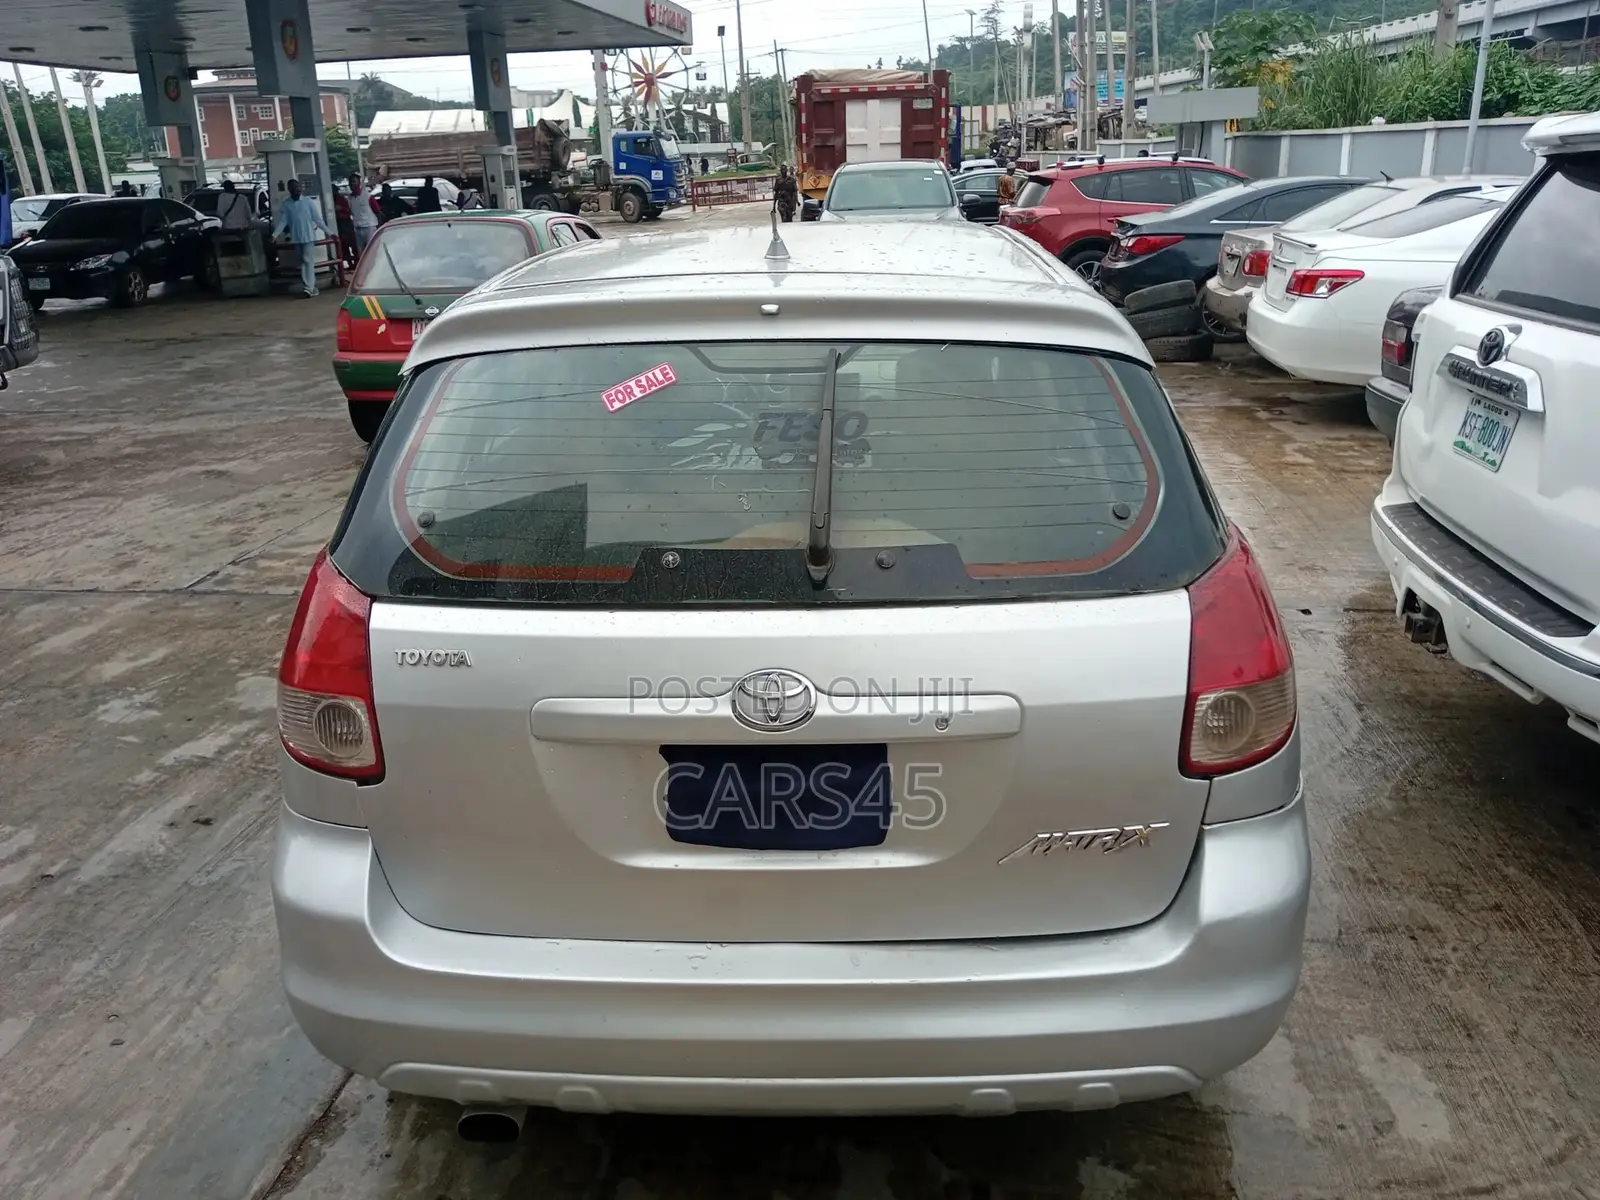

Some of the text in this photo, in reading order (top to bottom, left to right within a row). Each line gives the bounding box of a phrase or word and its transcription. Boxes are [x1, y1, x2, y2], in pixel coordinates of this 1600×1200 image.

[604, 366, 674, 409] FOR SALE
[394, 648, 472, 667] TOYOTA
